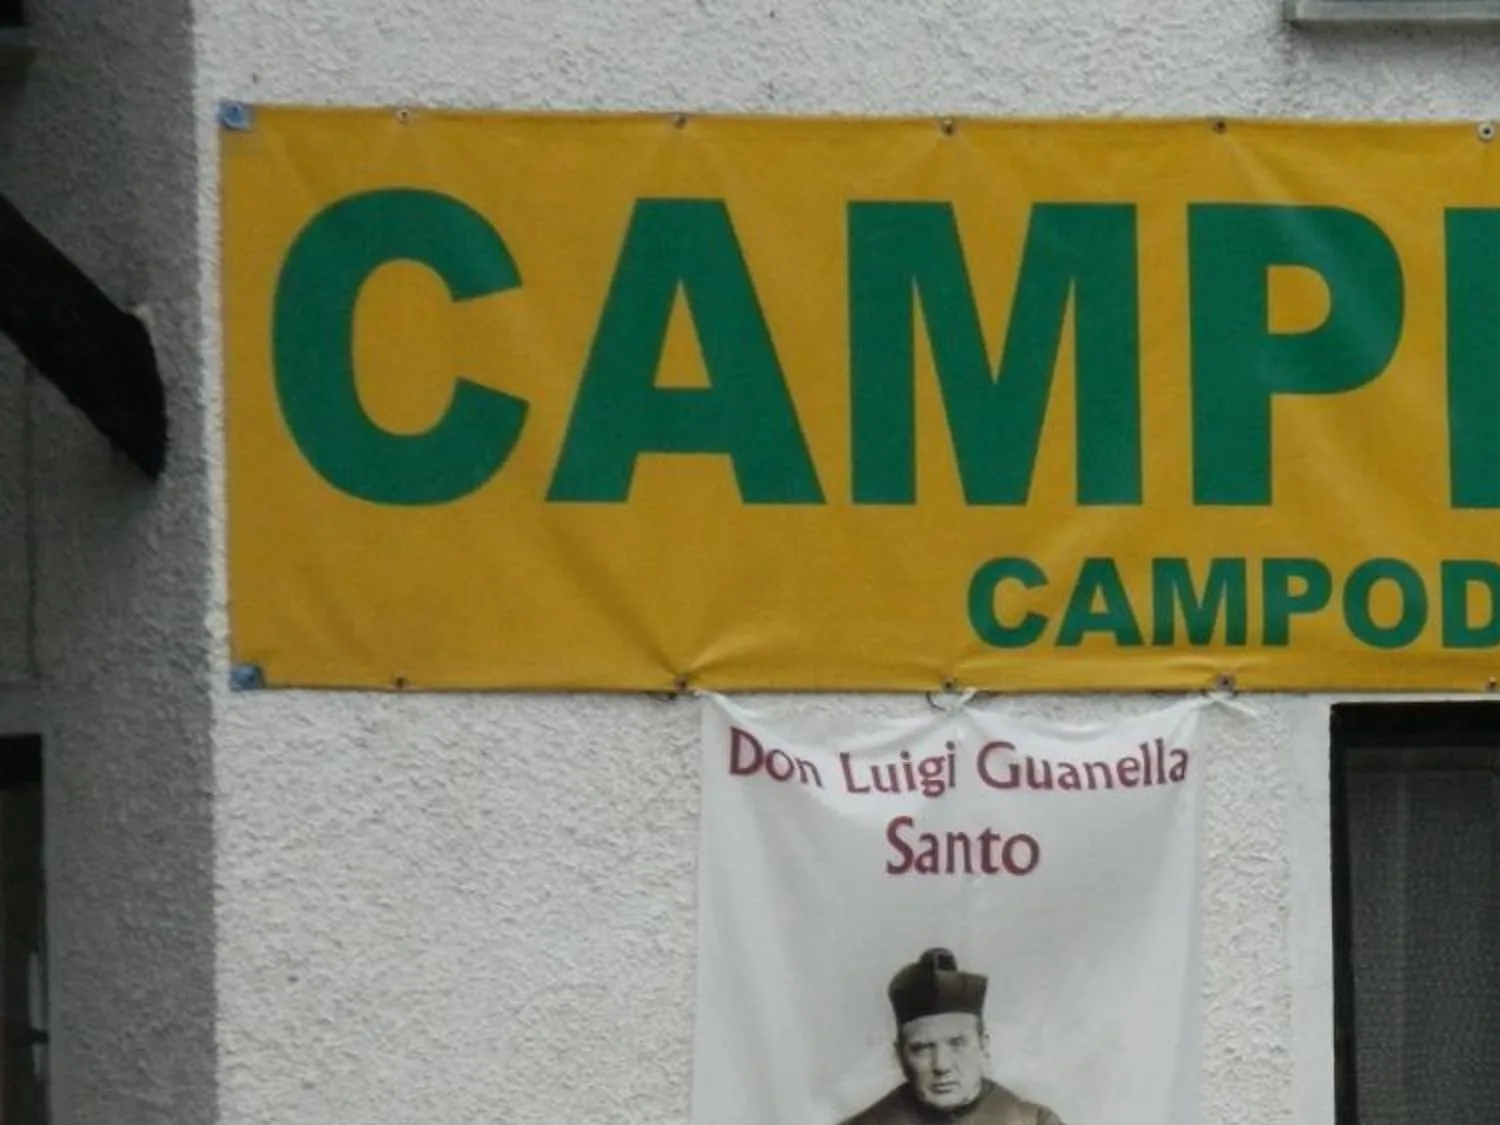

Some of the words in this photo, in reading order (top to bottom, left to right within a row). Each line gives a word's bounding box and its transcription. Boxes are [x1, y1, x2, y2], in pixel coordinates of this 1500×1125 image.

[728, 726, 823, 789] Don
[839, 741, 957, 797] Luigi
[976, 738, 1188, 791] Guanella
[885, 816, 1040, 876] Santo
